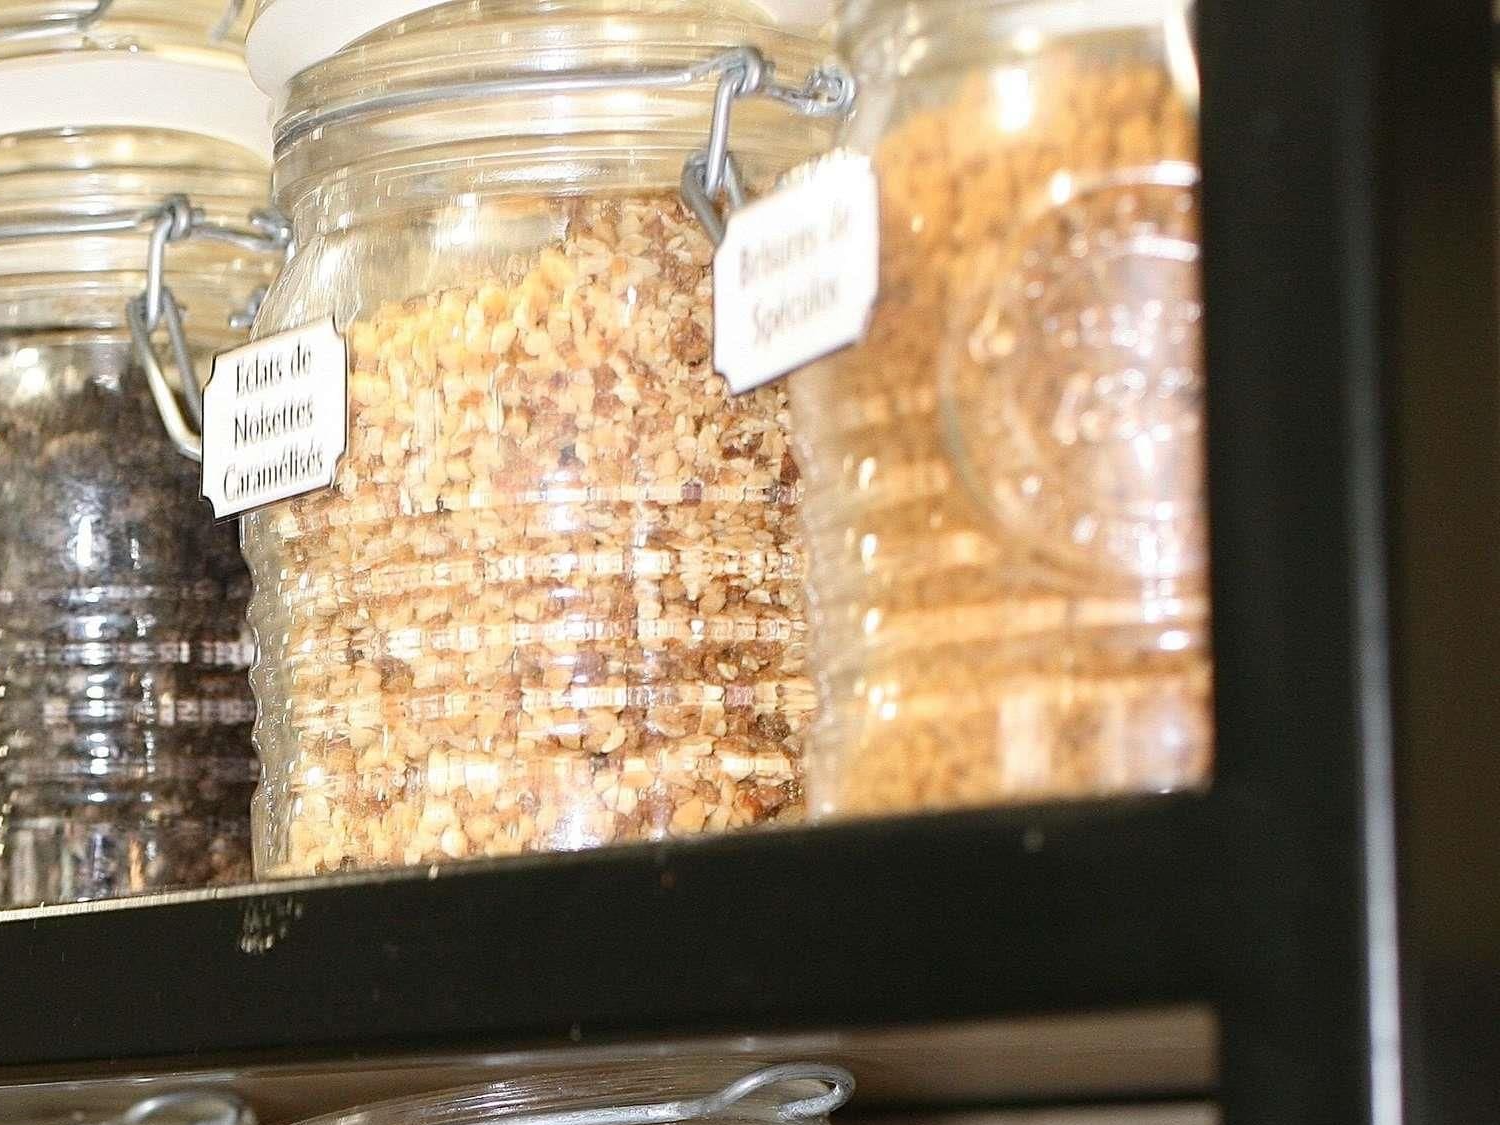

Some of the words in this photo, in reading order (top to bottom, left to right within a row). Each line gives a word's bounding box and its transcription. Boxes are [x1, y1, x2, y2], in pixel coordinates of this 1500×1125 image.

[739, 224, 819, 289] Brisures
[235, 352, 283, 398] Eclats
[290, 343, 311, 376] de
[234, 394, 313, 449] Noisettes
[223, 435, 323, 503] Caramélisés
